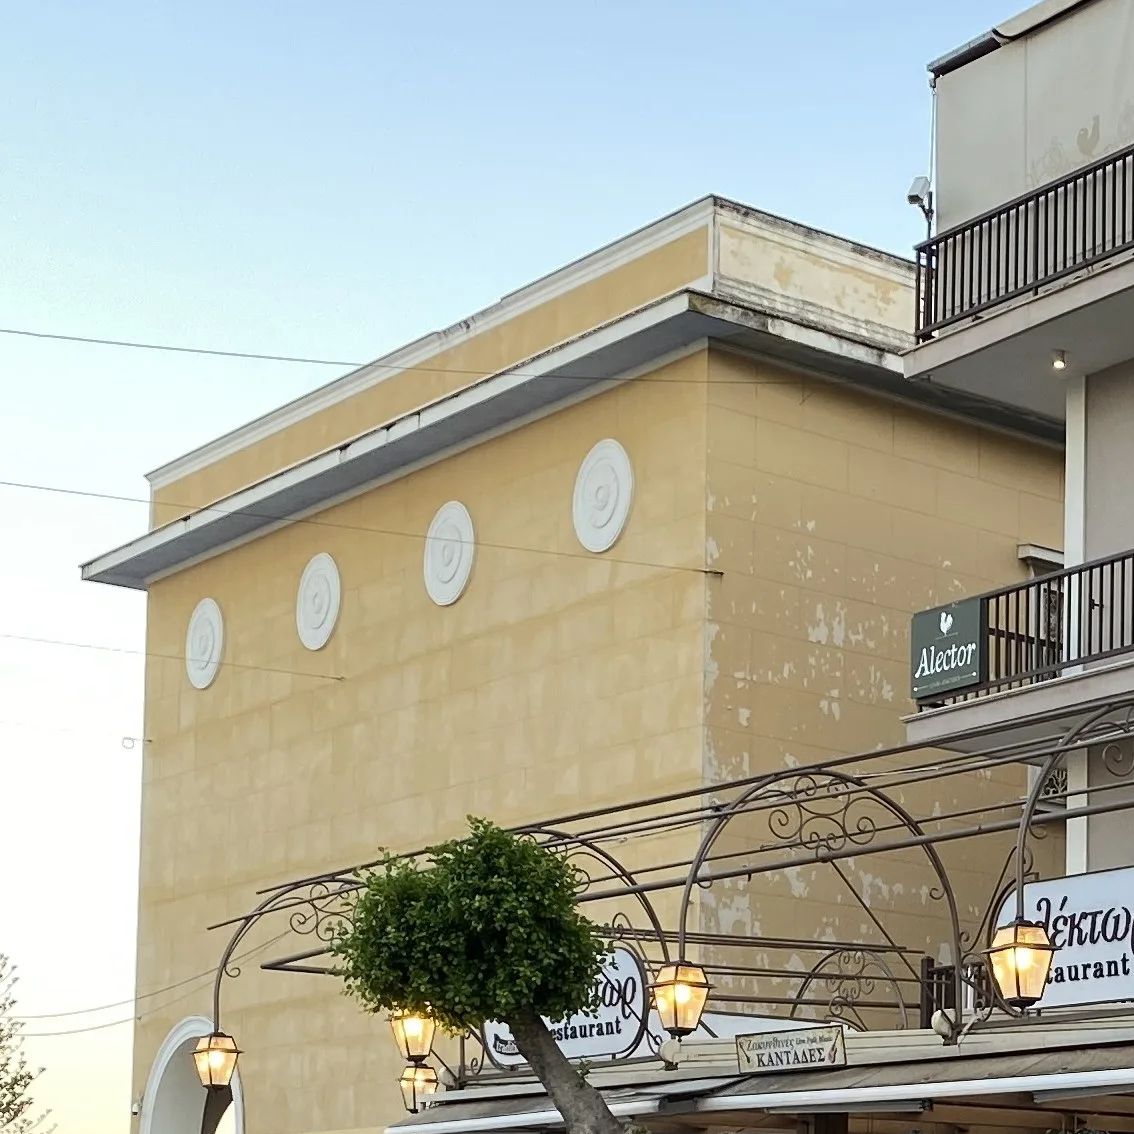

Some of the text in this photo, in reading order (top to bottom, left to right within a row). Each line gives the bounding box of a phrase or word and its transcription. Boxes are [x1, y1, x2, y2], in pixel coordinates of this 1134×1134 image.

[914, 642, 977, 679] Alector
[1046, 952, 1130, 984] taurant
[549, 1015, 622, 1043] estaurant
[756, 1047, 826, 1068] ΚΑΝΤΑΔΕΣ
